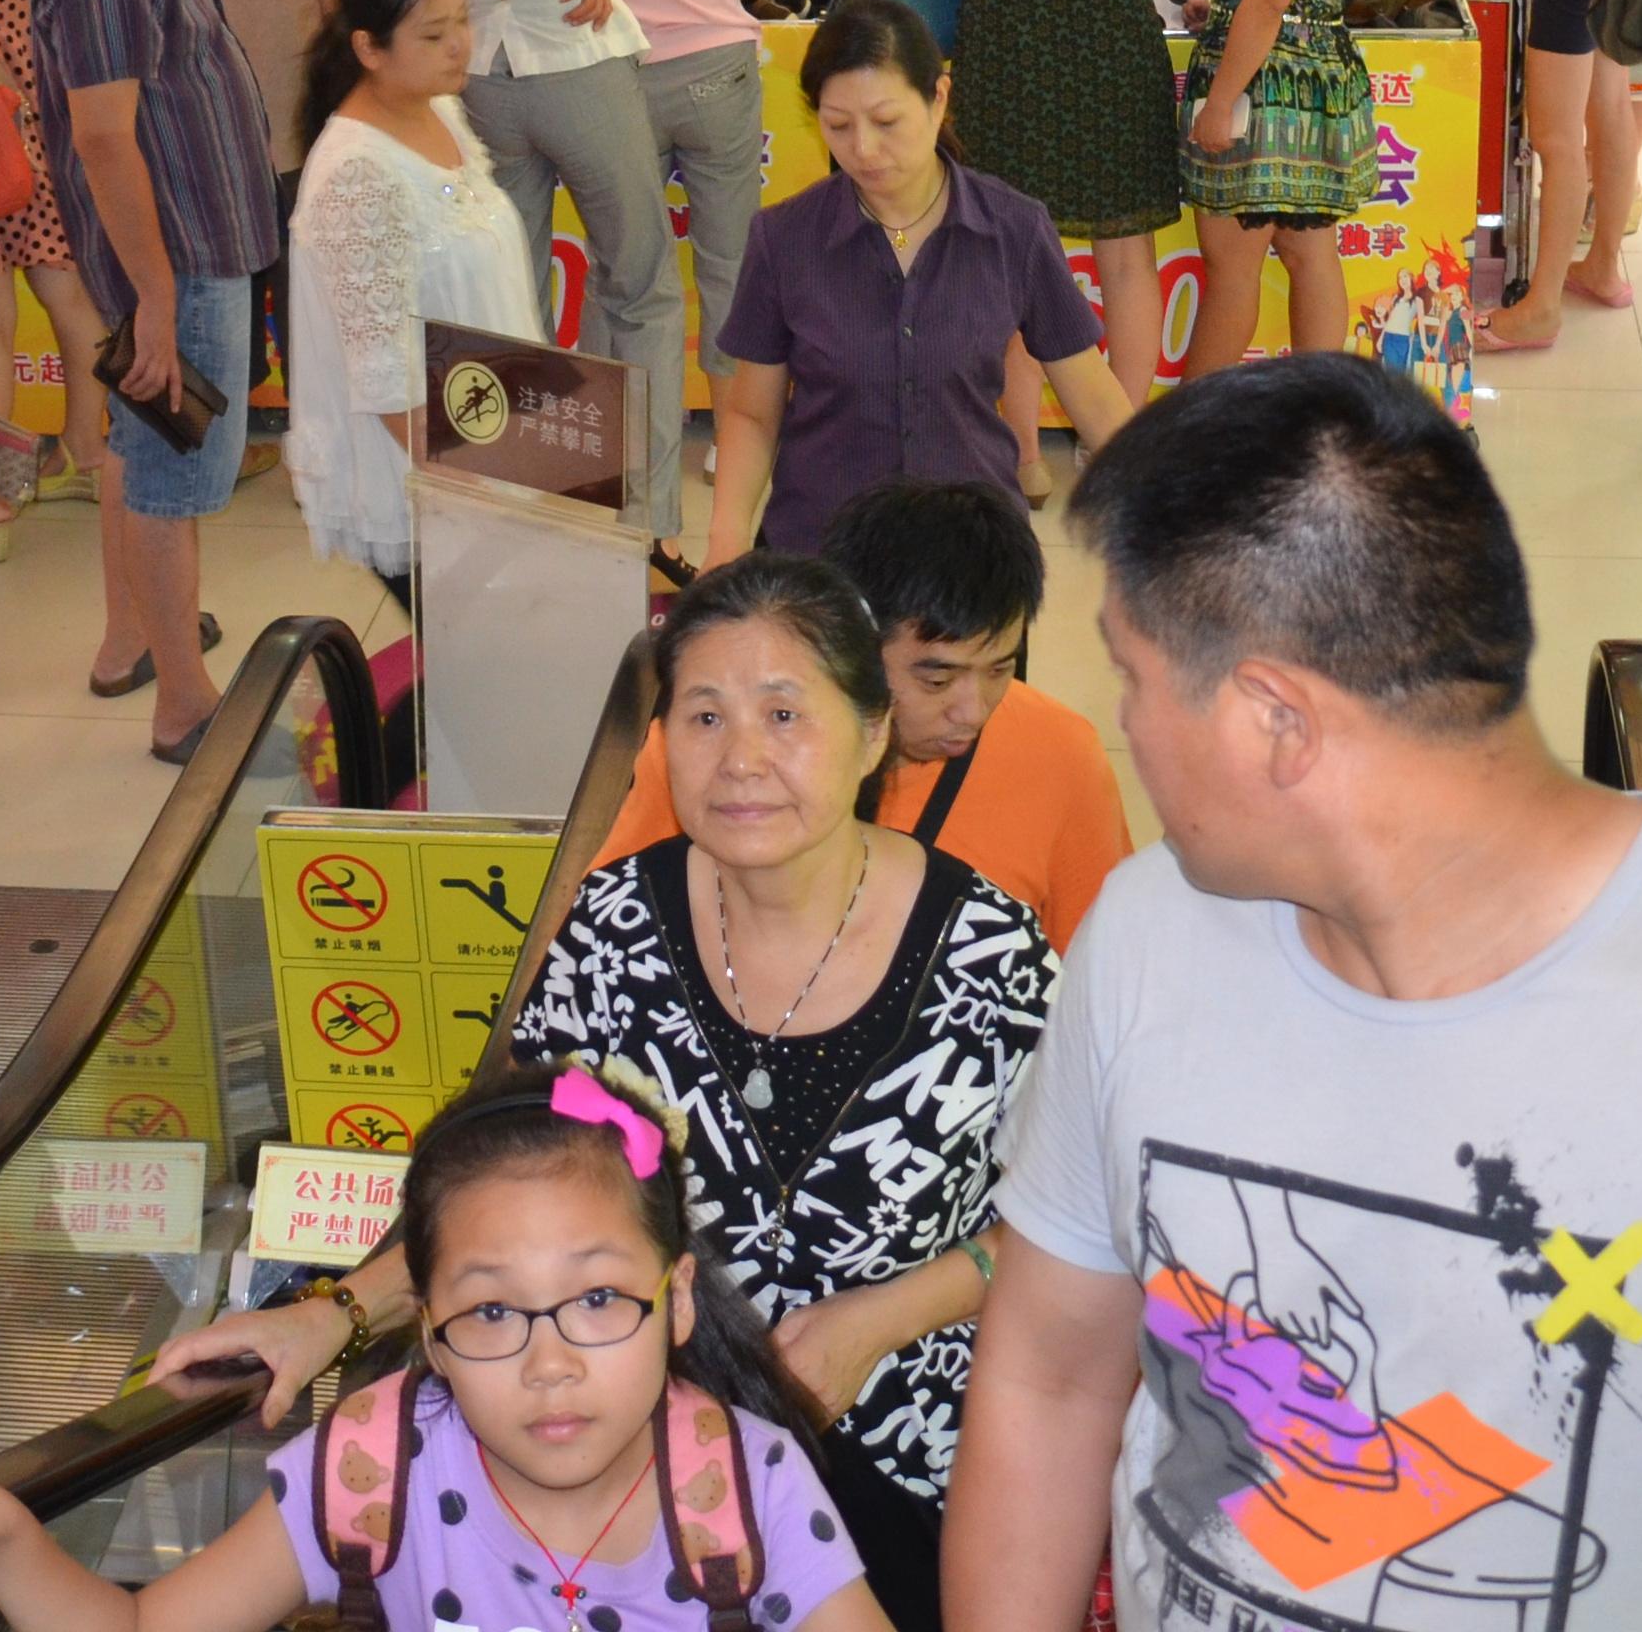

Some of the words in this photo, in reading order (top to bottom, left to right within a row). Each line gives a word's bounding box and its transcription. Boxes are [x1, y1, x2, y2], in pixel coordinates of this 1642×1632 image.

[517, 385, 604, 429] 注意安全
[517, 414, 604, 459] 严禁攀爬
[314, 937, 382, 952] 禁止吸烟
[294, 1169, 399, 1208] 公共场
